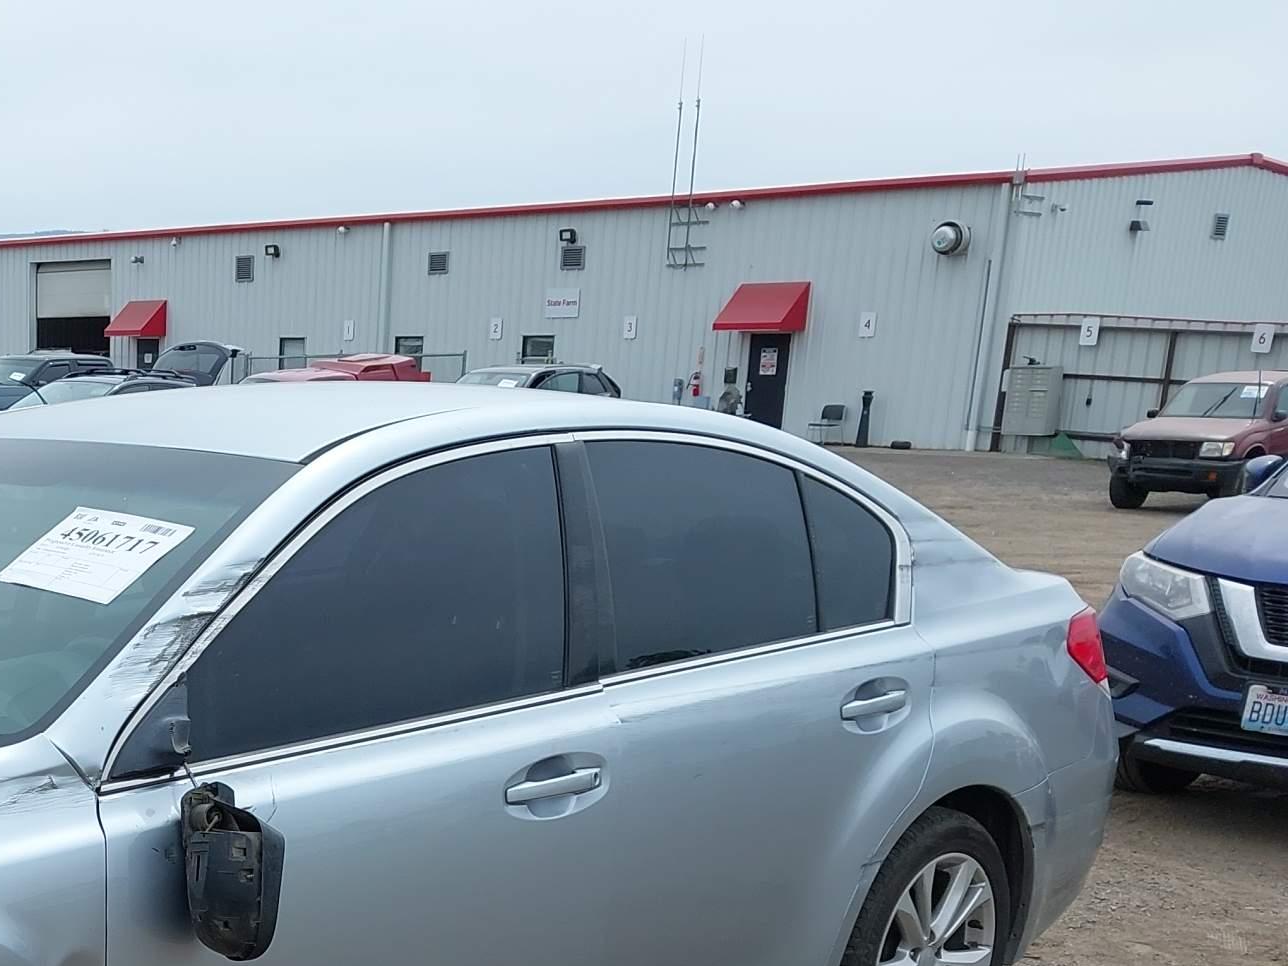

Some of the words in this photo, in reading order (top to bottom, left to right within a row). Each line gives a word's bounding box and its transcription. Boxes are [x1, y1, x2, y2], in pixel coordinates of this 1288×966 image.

[547, 299, 561, 307] State
[562, 299, 578, 307] Farm
[1086, 326, 1093, 338] 5
[1258, 332, 1266, 344] 6
[60, 525, 160, 555] 45061717
